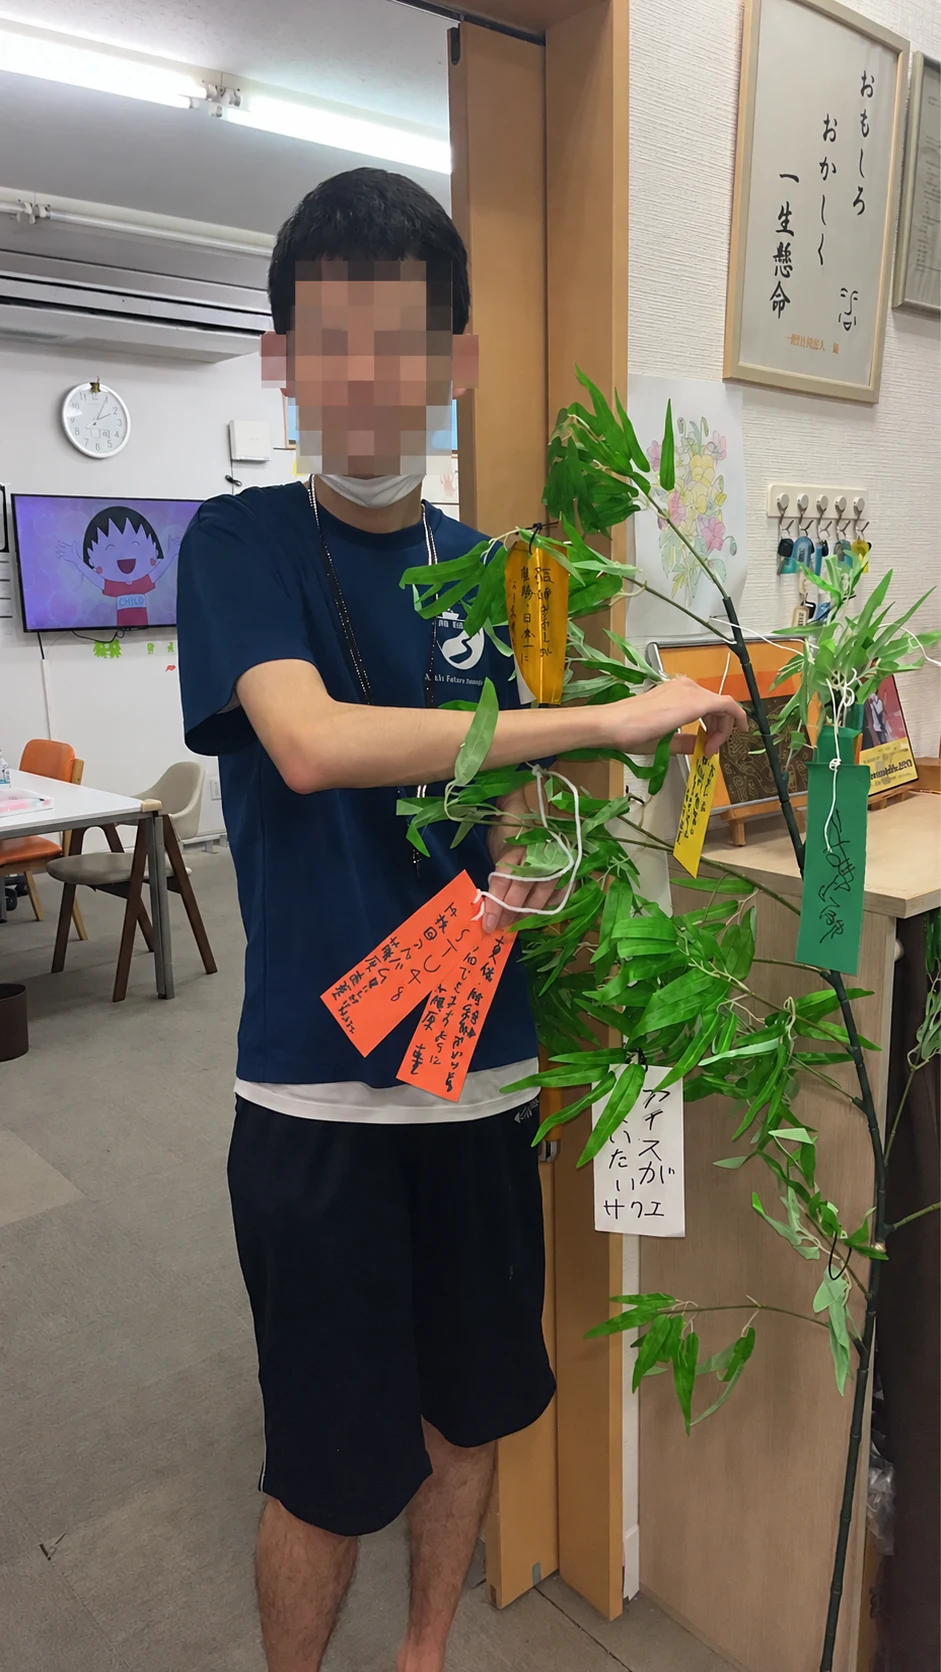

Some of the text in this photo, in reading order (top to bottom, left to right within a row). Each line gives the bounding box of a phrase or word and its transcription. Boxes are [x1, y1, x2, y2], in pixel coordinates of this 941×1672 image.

[852, 69, 875, 216] おもしろ
[817, 112, 838, 267] おかしく
[769, 171, 800, 320] 一生懸命
[119, 597, 144, 607] CHILD
[390, 928, 470, 1002] STU48
[608, 1119, 635, 1192] いたい
[638, 1089, 676, 1185] アイスが
[603, 1198, 665, 1220] サクエ
